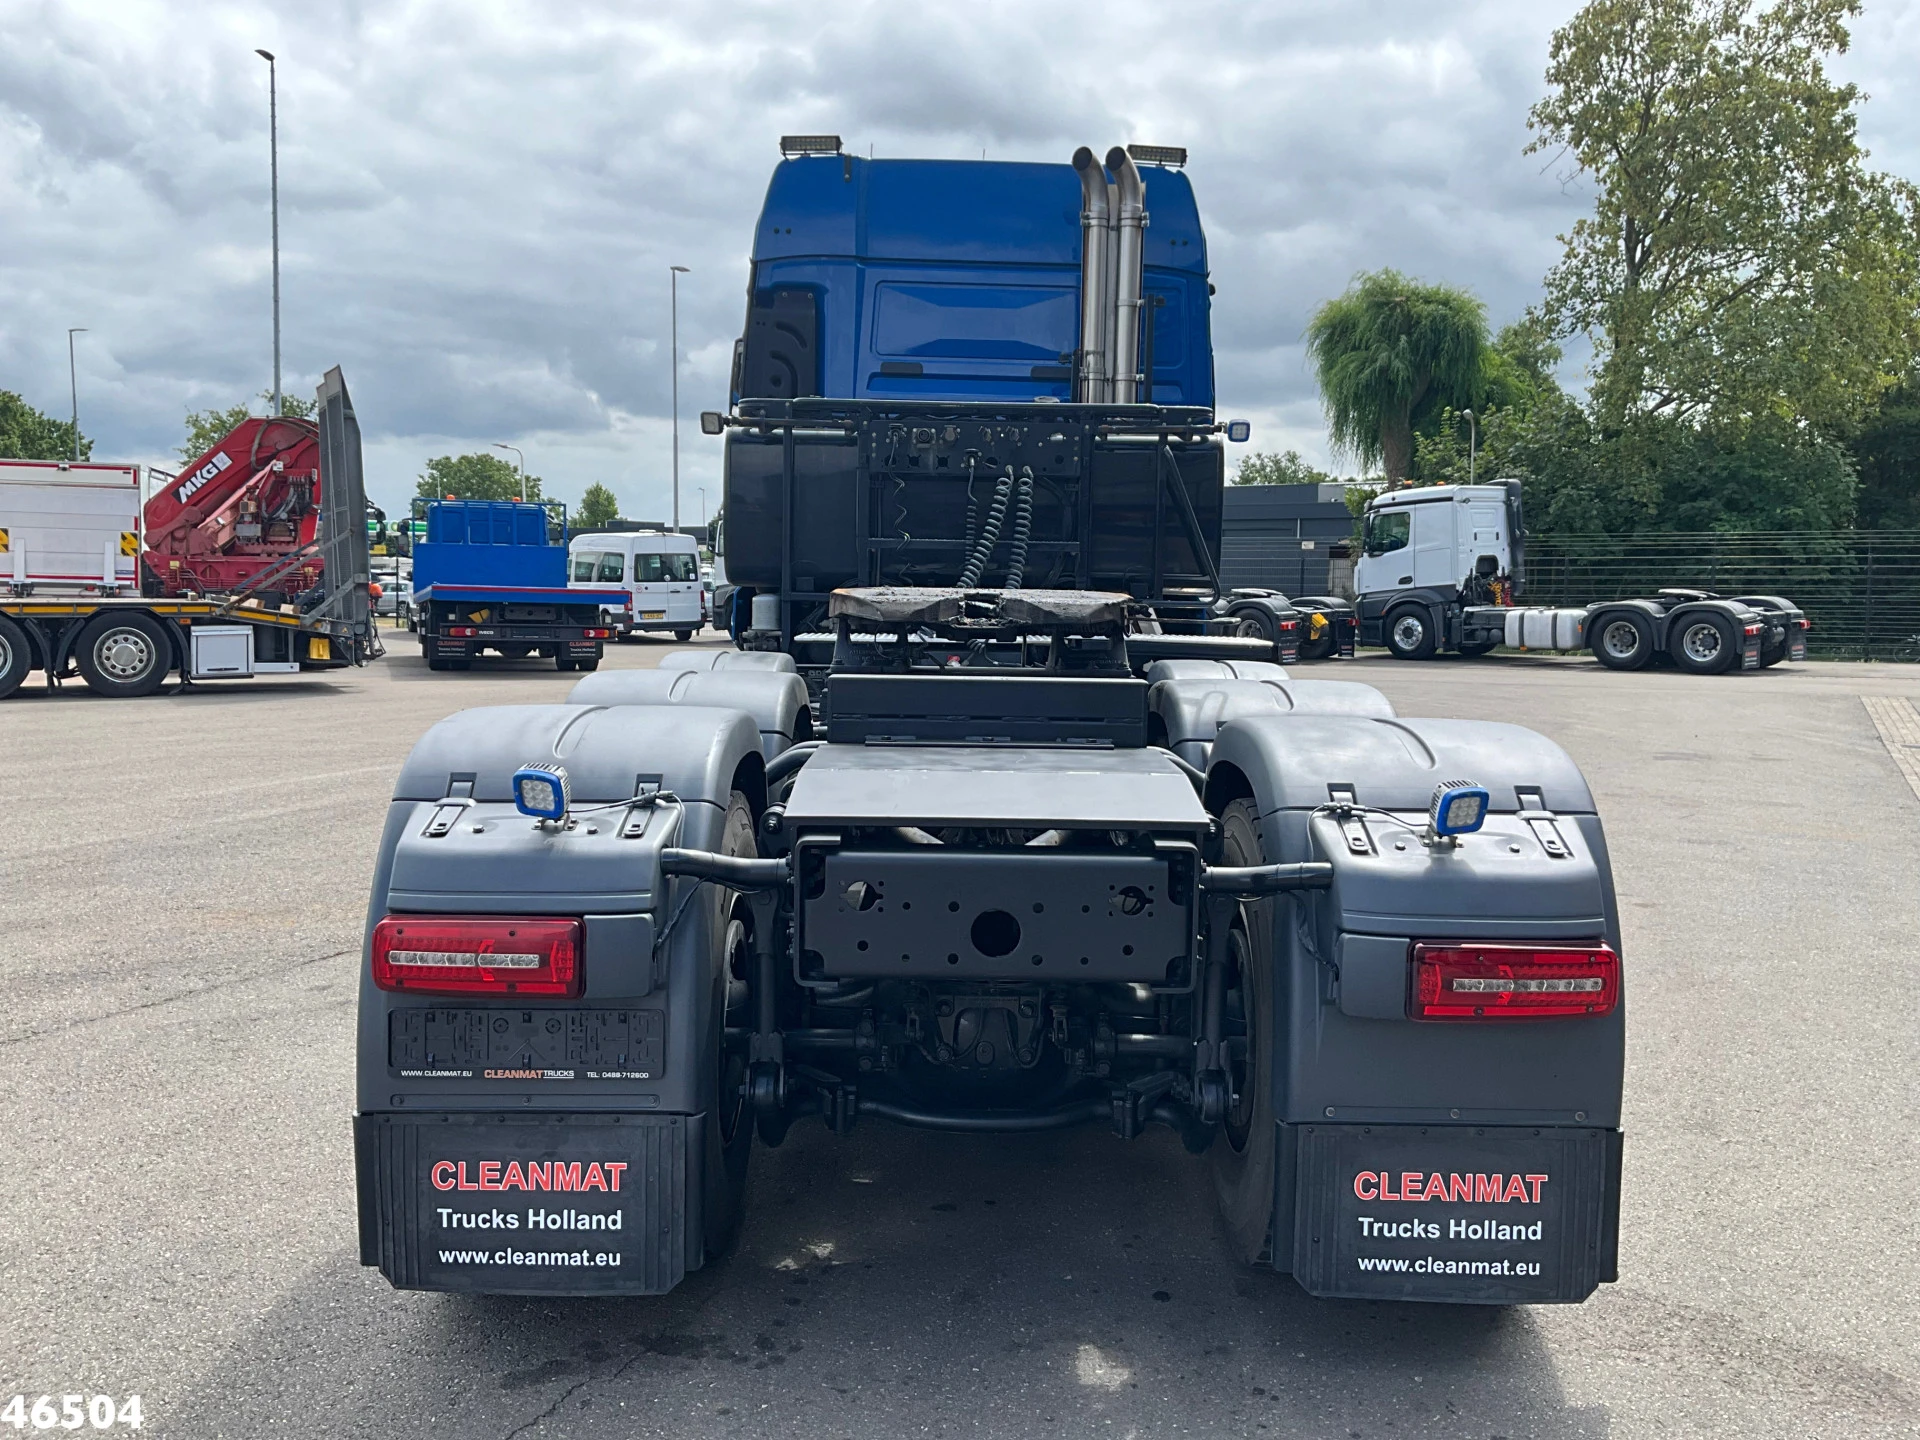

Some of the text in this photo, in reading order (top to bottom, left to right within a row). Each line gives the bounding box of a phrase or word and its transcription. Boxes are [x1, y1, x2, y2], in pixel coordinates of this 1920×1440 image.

[178, 462, 219, 504] MKG
[431, 1160, 628, 1192] CLEANMAT
[1353, 1170, 1549, 1204] CLEANMAT
[436, 1207, 623, 1231] Trucks Holland
[1357, 1216, 1543, 1241] Trucks Holland
[438, 1247, 622, 1267] www.cleanmat.eu
[1357, 1256, 1541, 1276] www.cleanmat.eu
